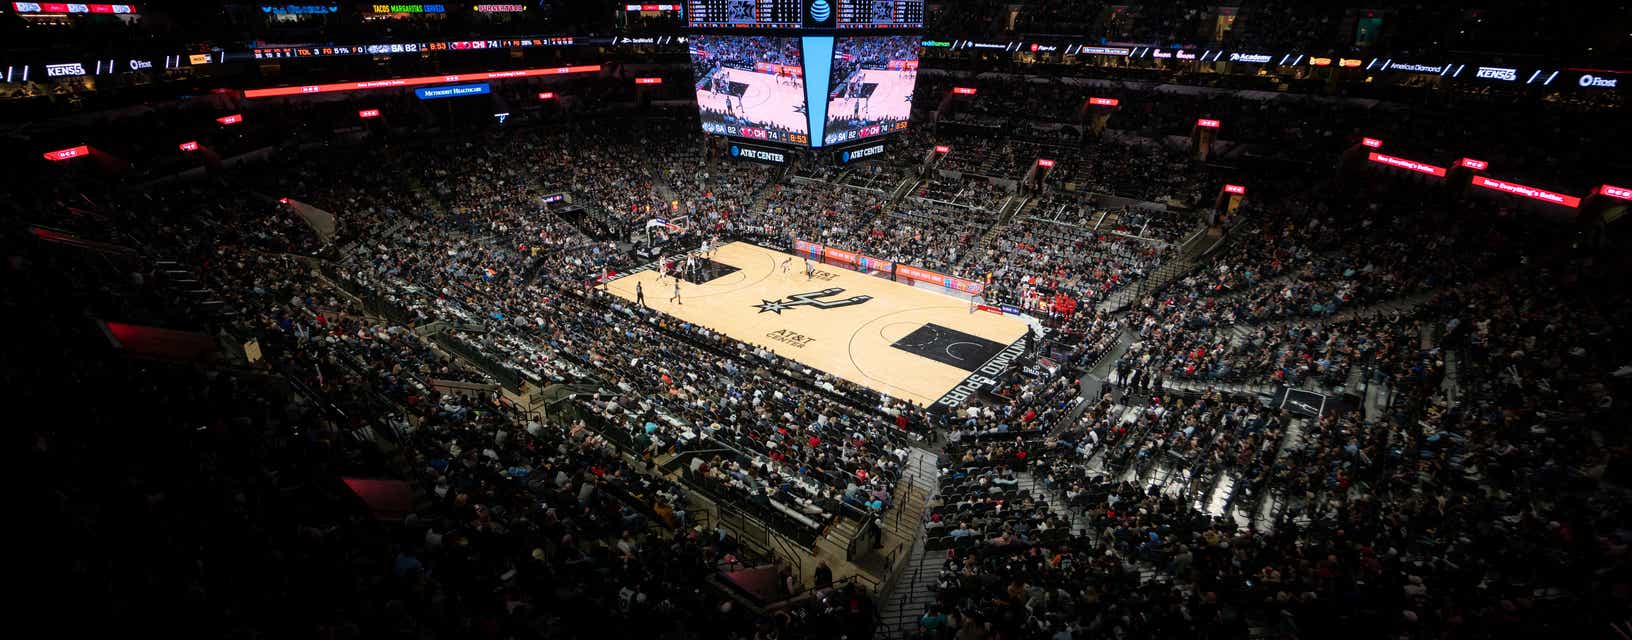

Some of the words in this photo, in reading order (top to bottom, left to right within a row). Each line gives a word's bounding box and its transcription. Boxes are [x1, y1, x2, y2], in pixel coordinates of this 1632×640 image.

[391, 44, 404, 52] SA
[405, 44, 417, 52] 82
[430, 42, 446, 50] 8:53
[472, 40, 485, 48] CHI
[487, 40, 498, 48] 74
[1415, 64, 1441, 73] Diamond
[1592, 77, 1617, 87] Frost
[715, 124, 726, 133] SA
[727, 126, 737, 134] 82
[754, 129, 766, 139] CHI
[768, 131, 778, 139] 74
[790, 134, 807, 144] 8:53
[838, 132, 847, 142] SA
[848, 130, 857, 139] 82
[869, 126, 880, 135] CHI
[880, 124, 888, 133] 74
[740, 149, 756, 158] AT&T
[757, 151, 785, 162] CENTER
[850, 149, 864, 160] AT&T
[864, 145, 884, 157] CENTER
[766, 333, 806, 348] CENTER
[769, 329, 816, 344] AT&T
[939, 374, 989, 408] SPURS
